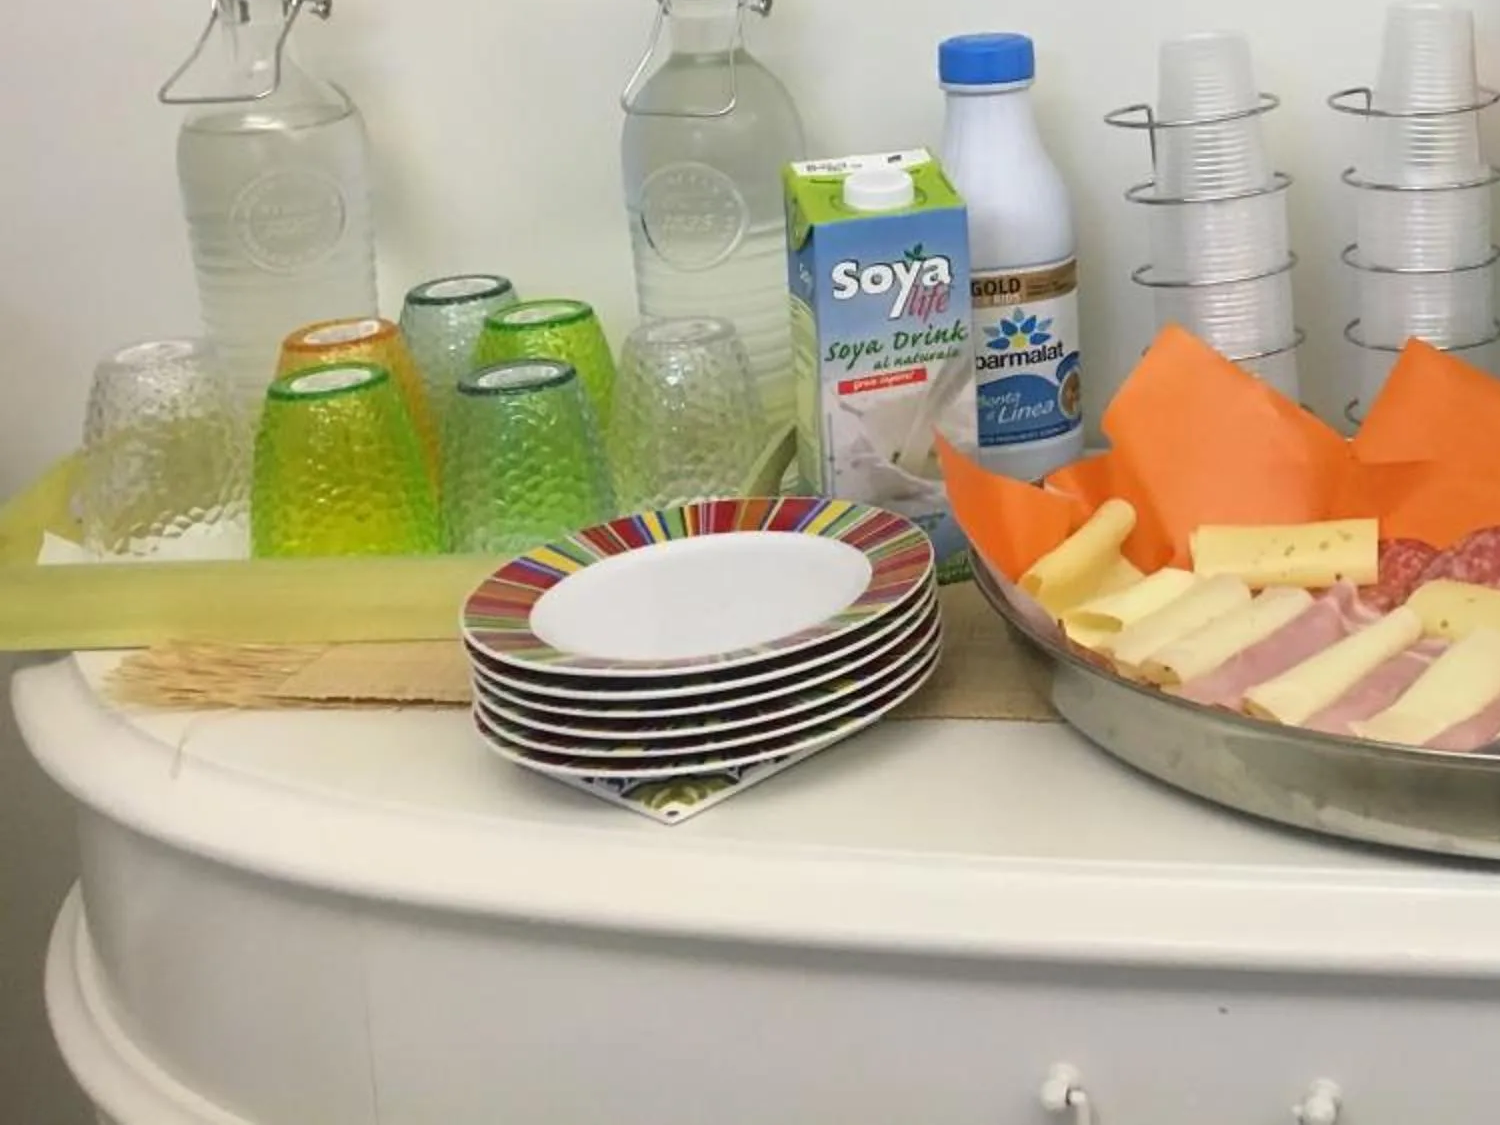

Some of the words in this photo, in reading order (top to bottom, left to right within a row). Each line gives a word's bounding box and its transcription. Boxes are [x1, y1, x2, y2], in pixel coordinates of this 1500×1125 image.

[970, 277, 1021, 297] GOLD
[893, 318, 970, 351] Drink
[975, 338, 1065, 371] parmalat
[997, 397, 1056, 425] Linea
